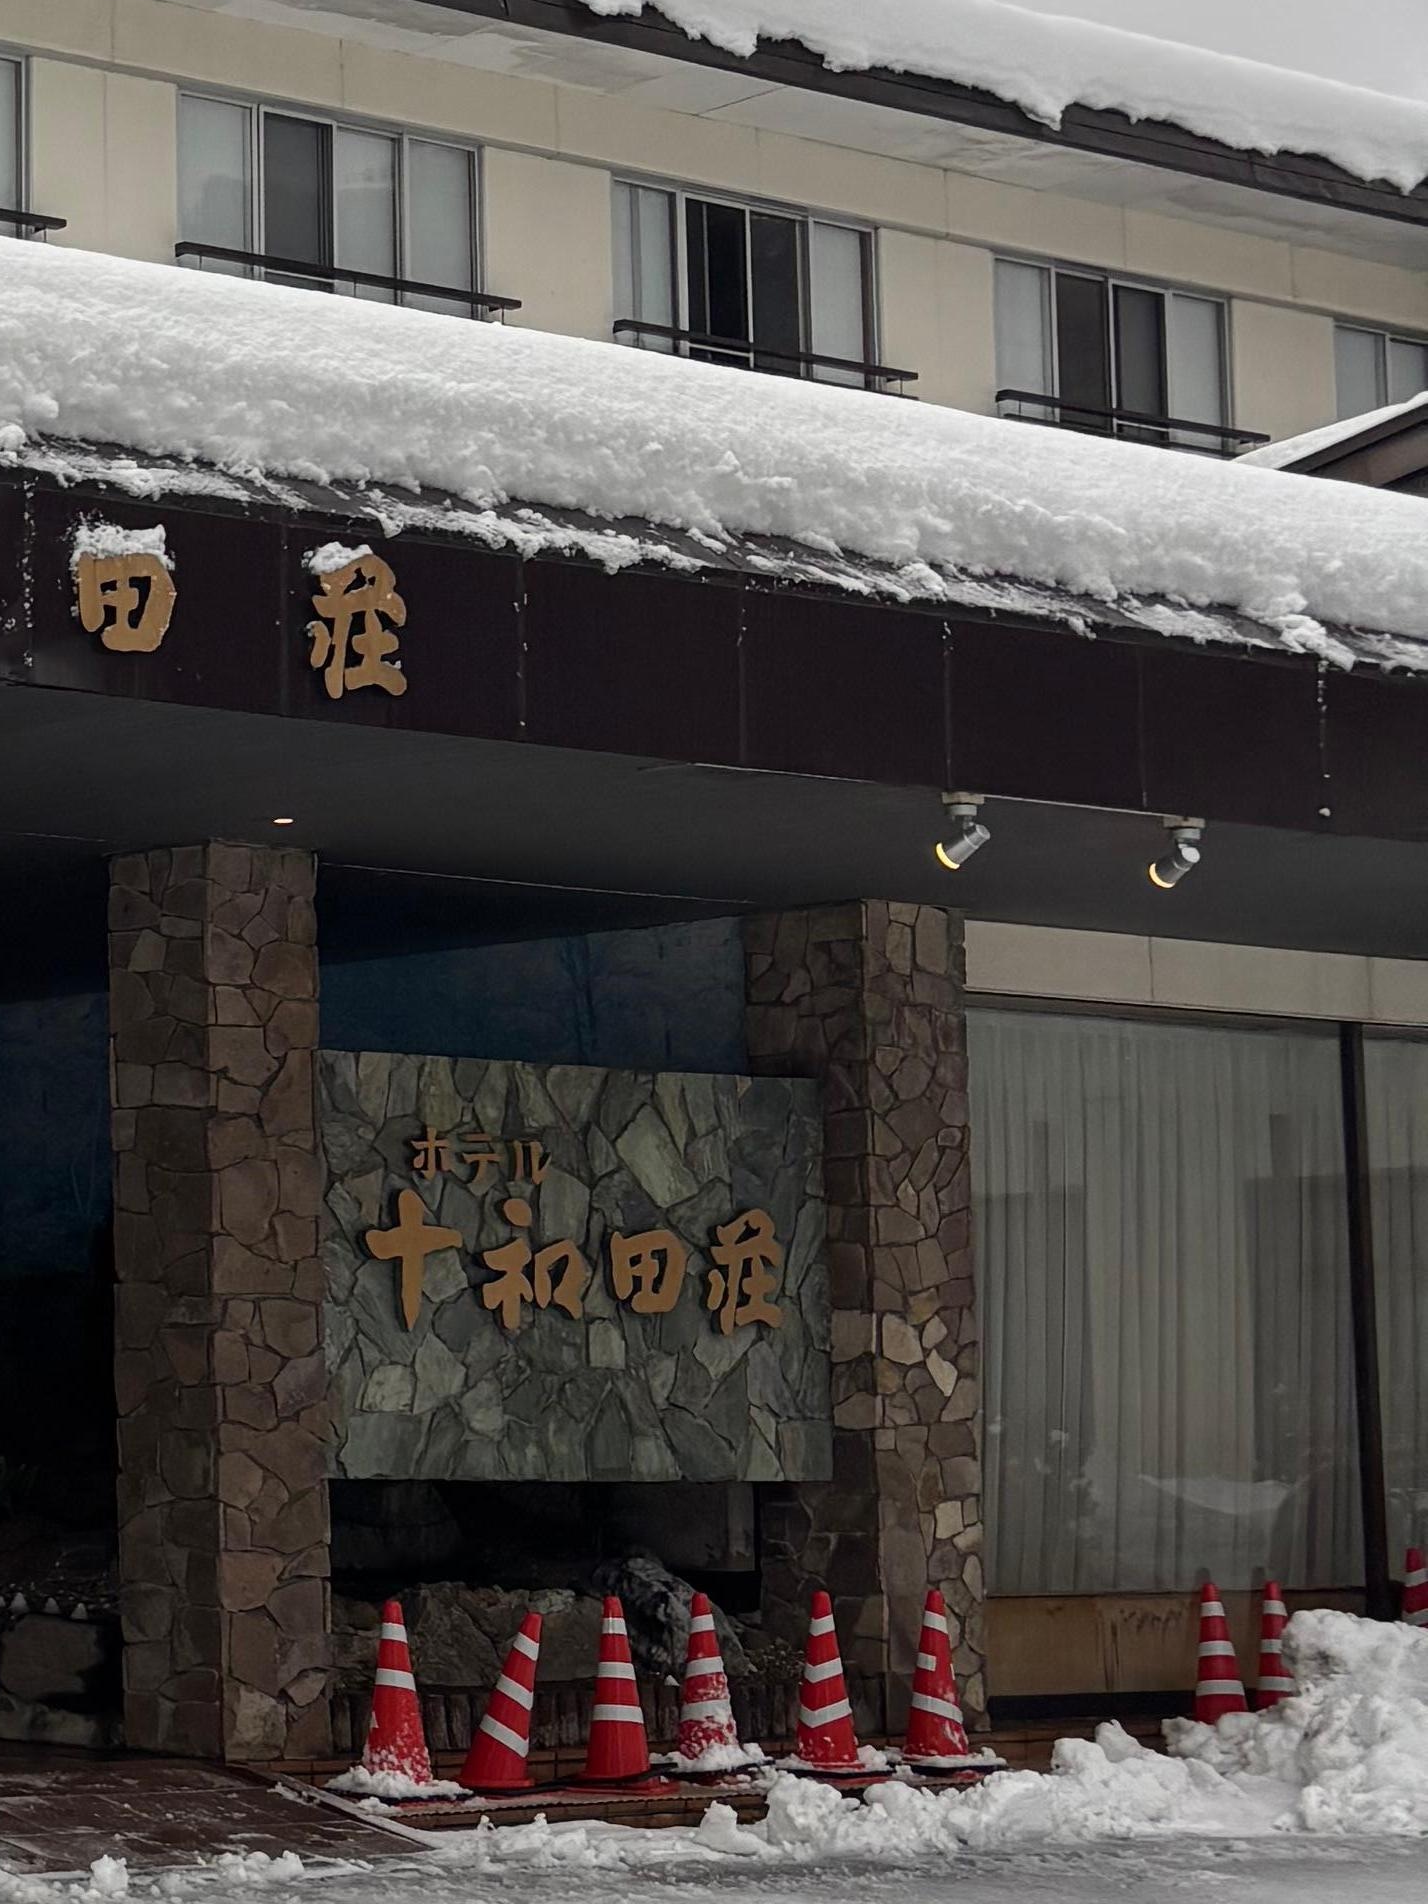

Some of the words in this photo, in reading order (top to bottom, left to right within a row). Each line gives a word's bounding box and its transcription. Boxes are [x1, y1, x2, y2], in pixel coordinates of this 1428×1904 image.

[411, 1126, 546, 1184] ホテル
[364, 1189, 784, 1336] 十和田荘
